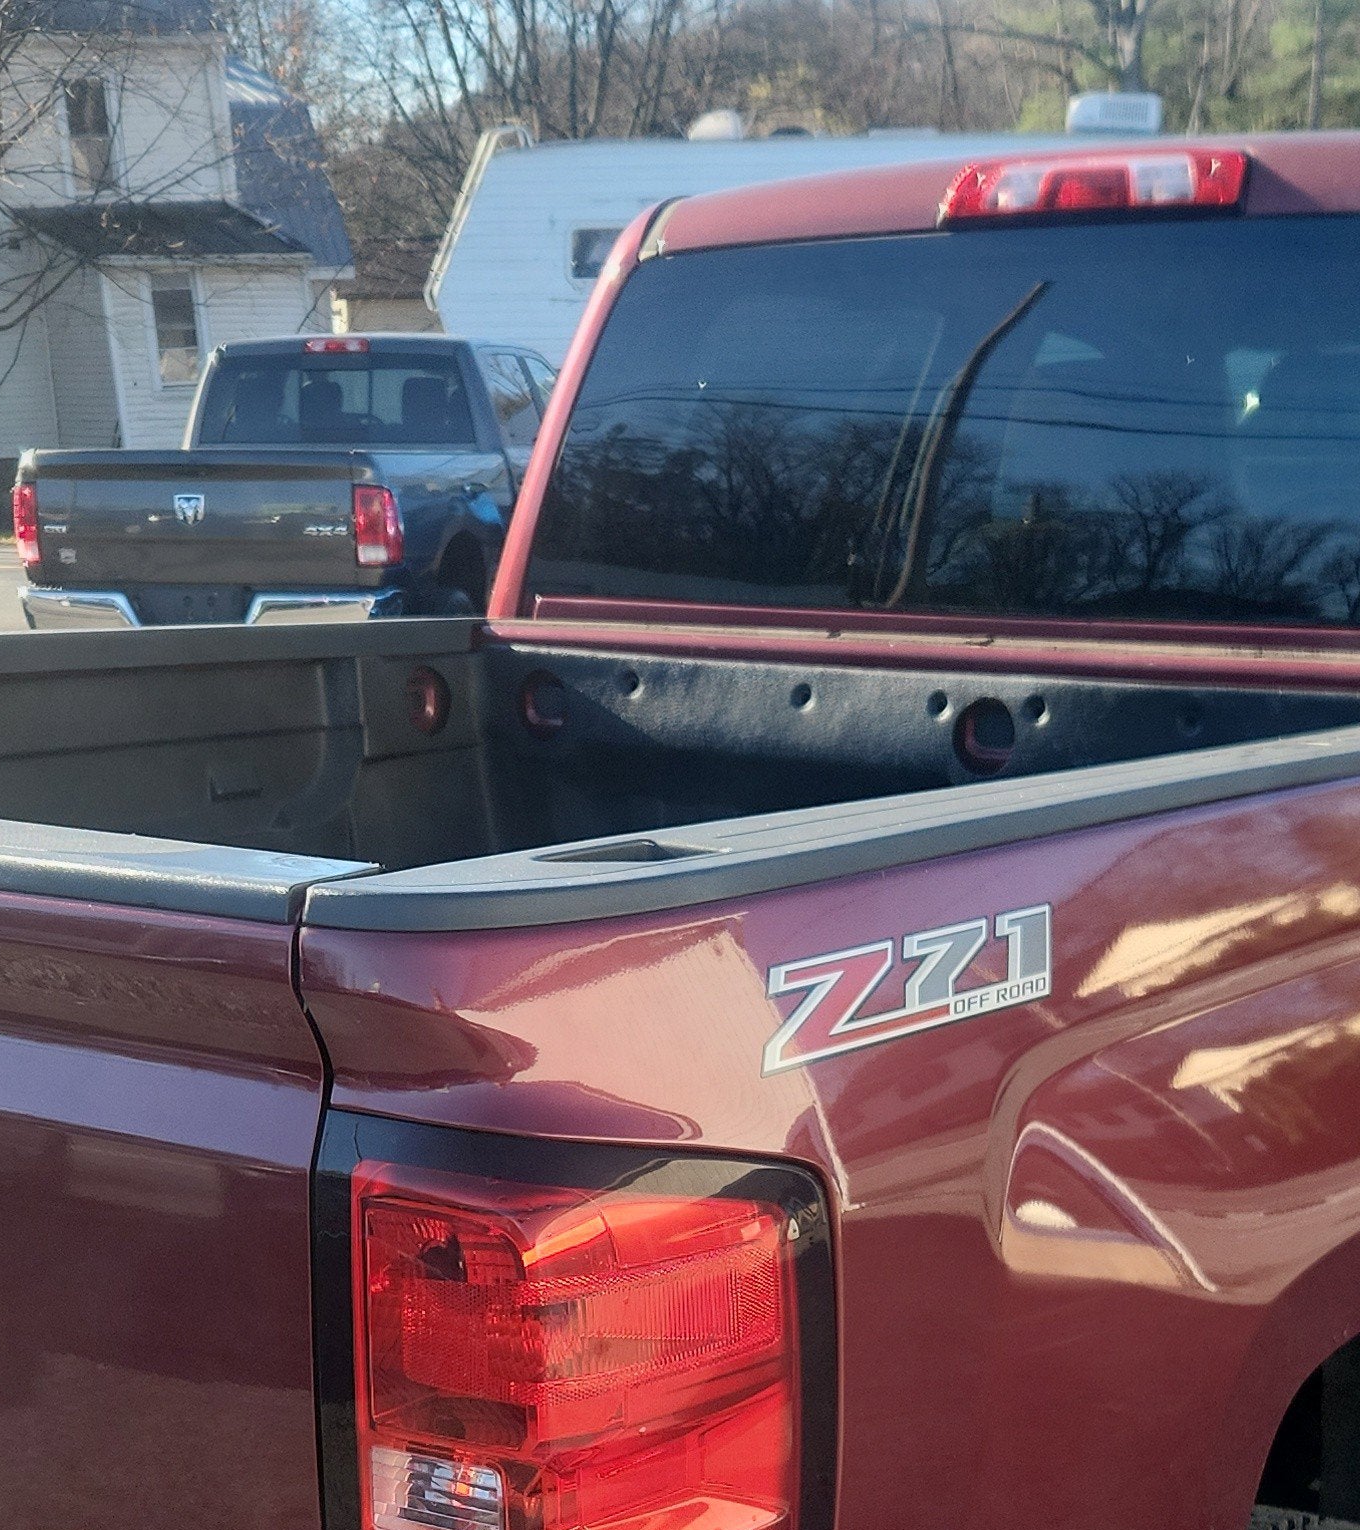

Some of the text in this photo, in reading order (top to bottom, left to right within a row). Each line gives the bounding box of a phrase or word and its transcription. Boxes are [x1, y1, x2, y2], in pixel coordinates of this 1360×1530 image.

[761, 902, 1052, 1079] Z71
[953, 976, 1046, 1015] OFF ROAD
